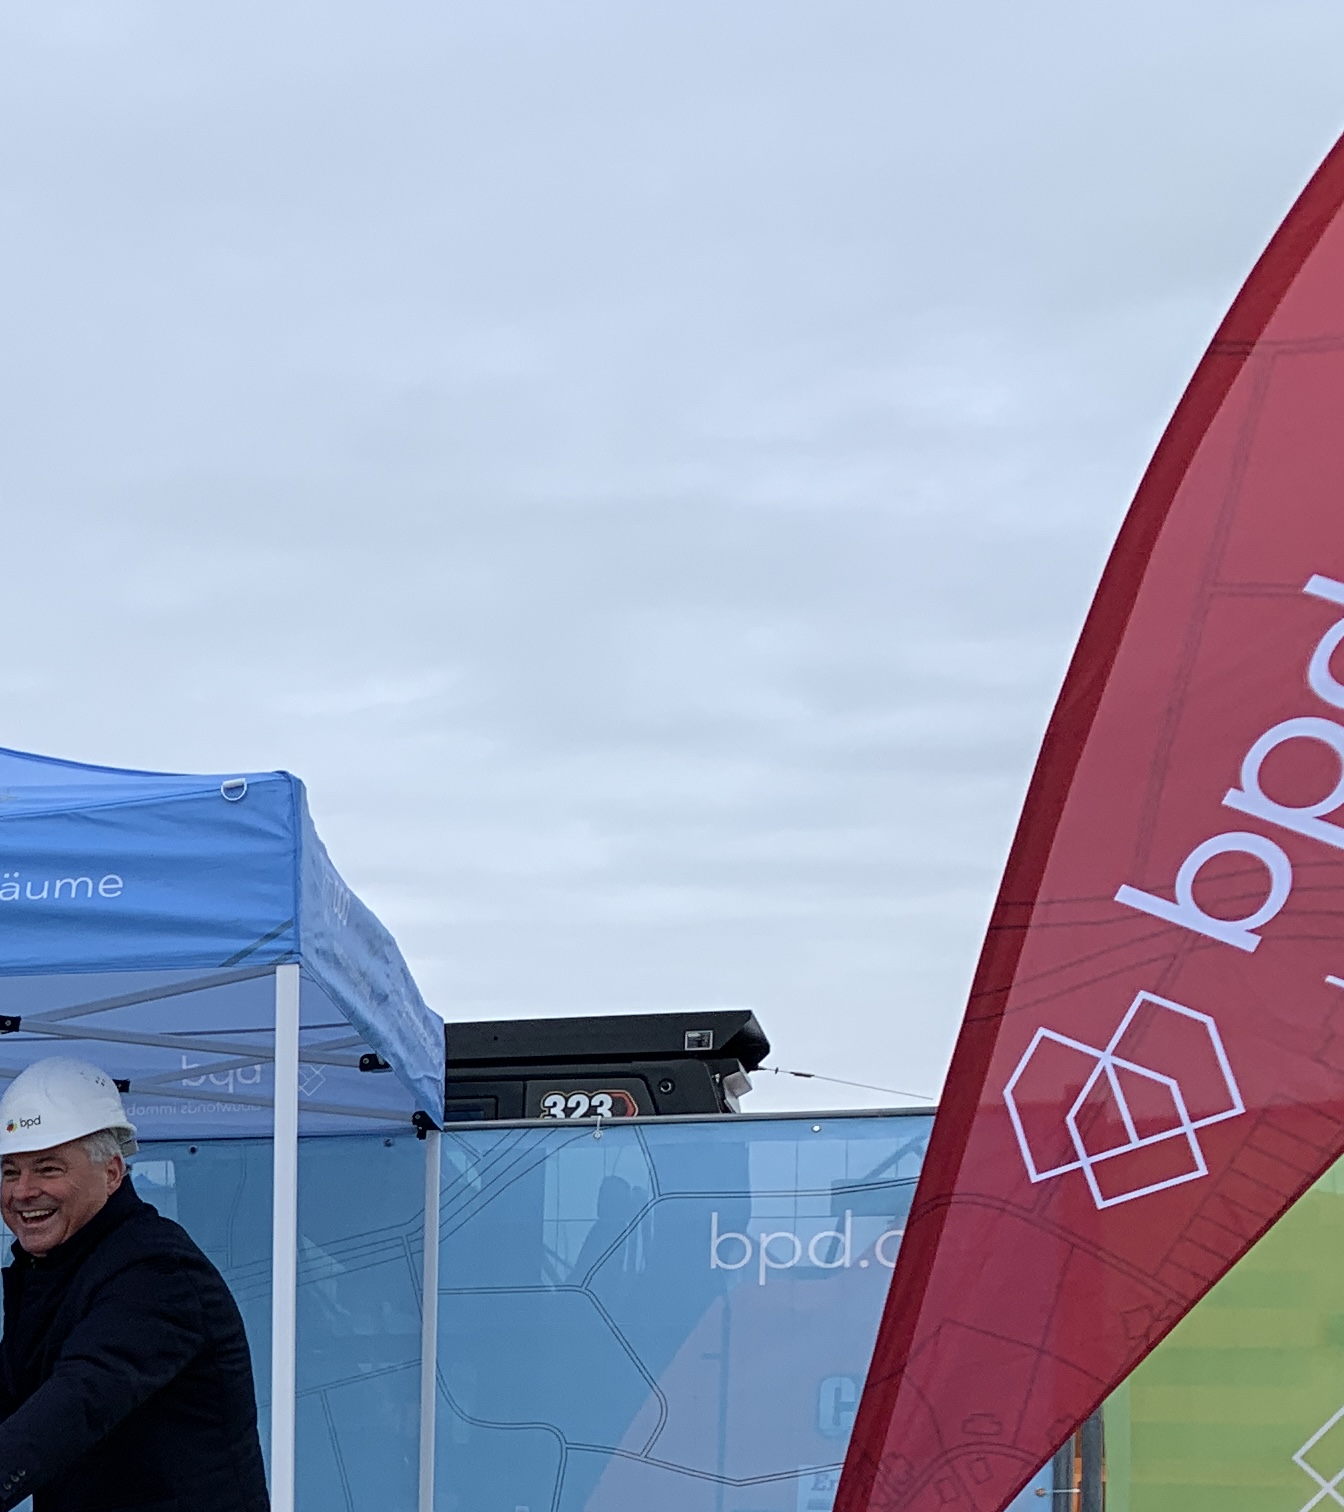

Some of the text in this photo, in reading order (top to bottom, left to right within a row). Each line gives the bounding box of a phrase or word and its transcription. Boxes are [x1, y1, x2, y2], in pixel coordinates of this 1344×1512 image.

[1114, 574, 1344, 953] bp
[543, 1092, 613, 1119] 323
[20, 1115, 41, 1129] bpd
